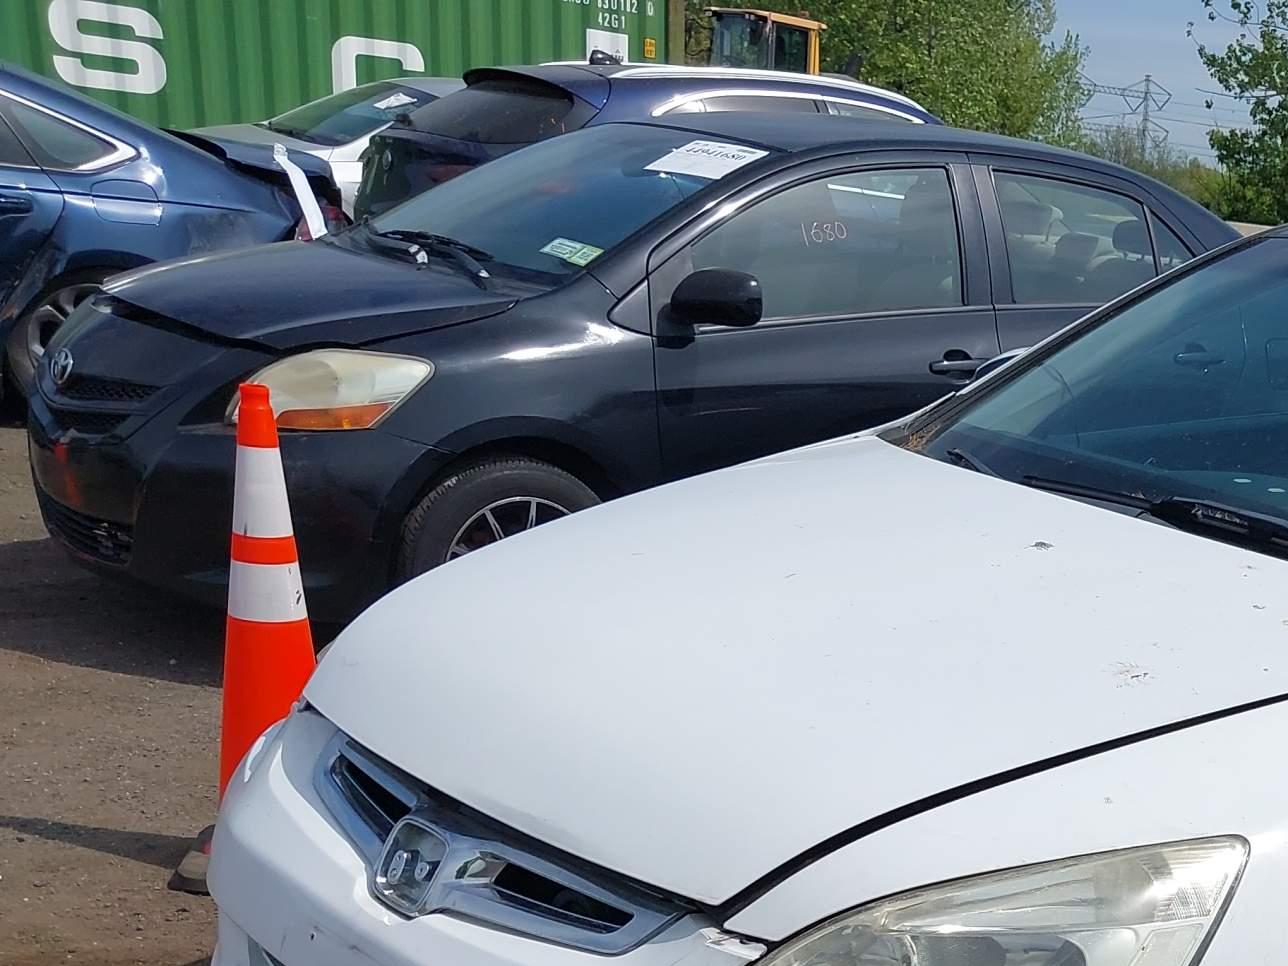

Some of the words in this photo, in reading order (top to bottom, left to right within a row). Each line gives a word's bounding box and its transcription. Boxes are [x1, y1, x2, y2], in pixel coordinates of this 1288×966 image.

[597, 12, 626, 29] 42G1
[48, 0, 167, 95] S
[801, 221, 847, 247] 1680
